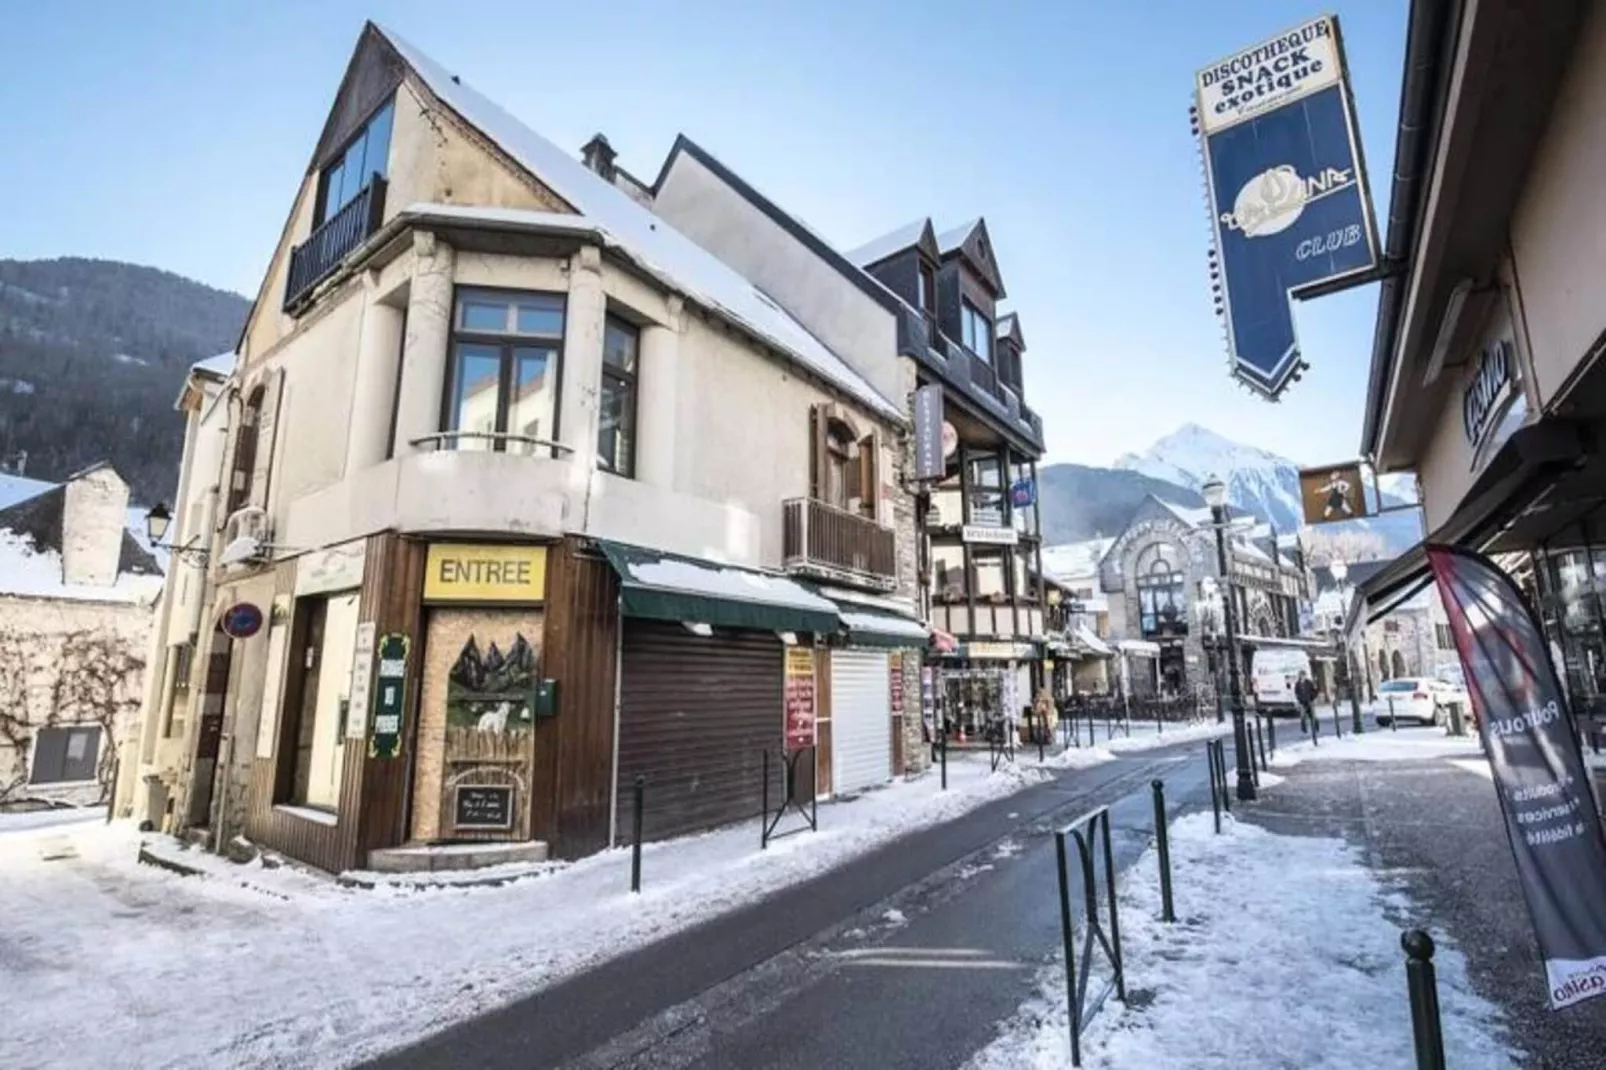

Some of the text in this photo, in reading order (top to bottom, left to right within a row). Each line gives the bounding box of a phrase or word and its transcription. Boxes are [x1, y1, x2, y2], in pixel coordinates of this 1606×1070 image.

[1202, 20, 1328, 87] DISCOTHEQUE
[1221, 47, 1310, 97] SNACK
[1214, 59, 1323, 114] exotique
[1296, 224, 1362, 261] CLUB
[440, 558, 531, 585] ENTREE
